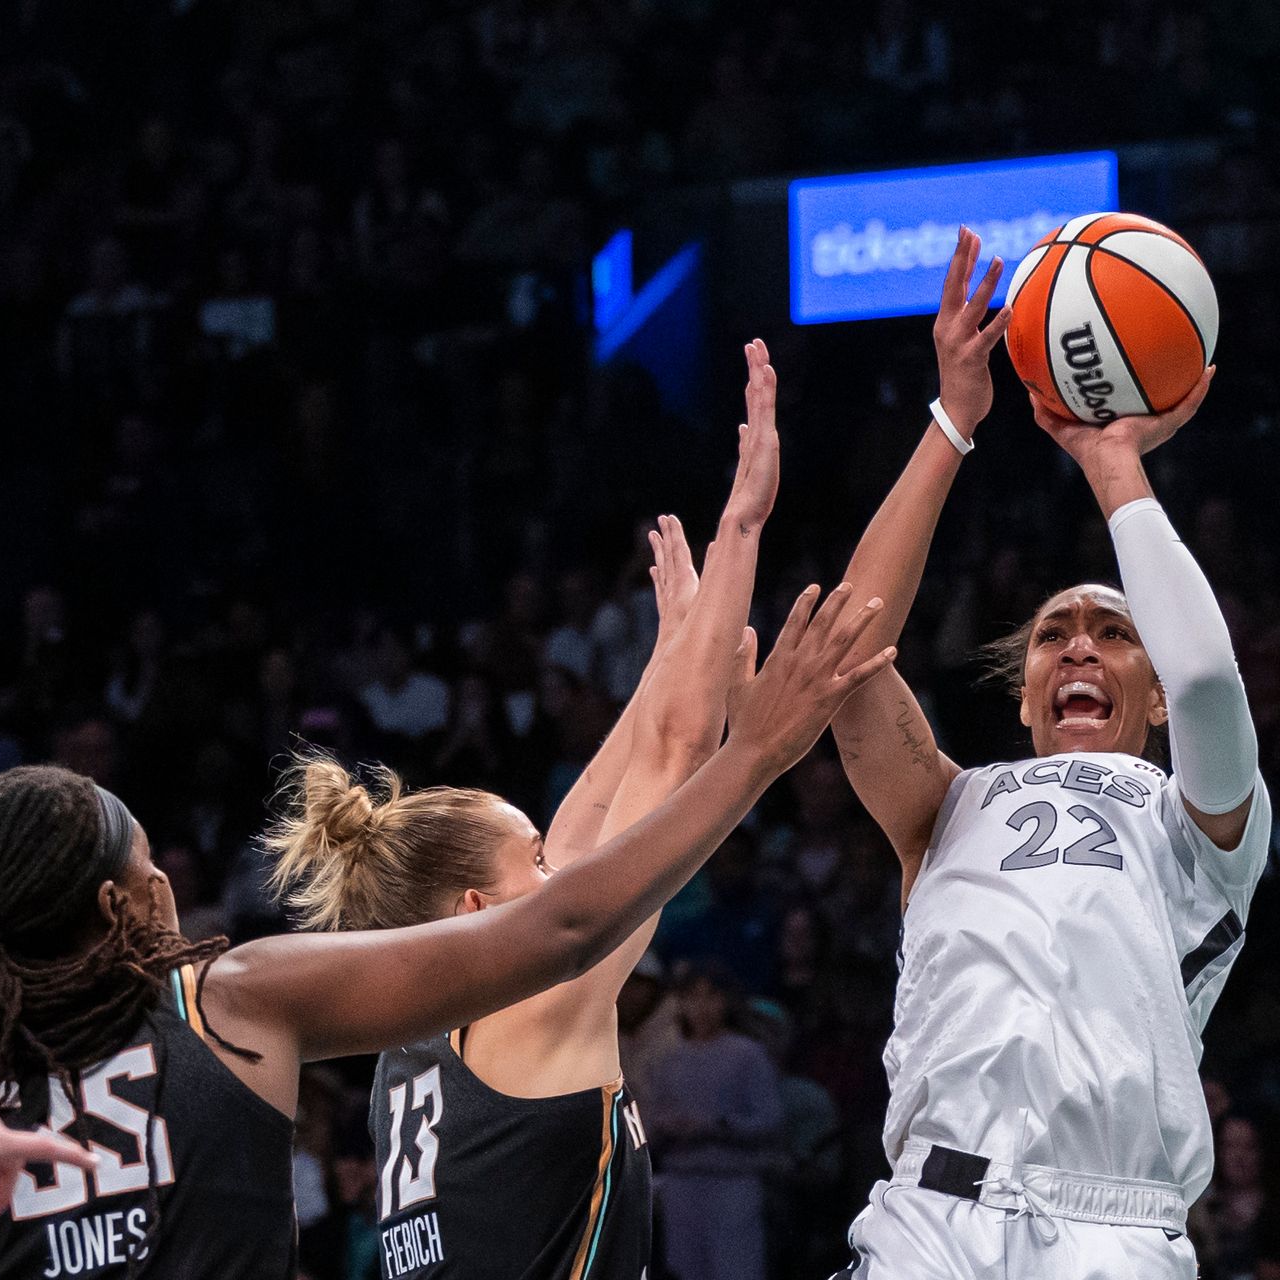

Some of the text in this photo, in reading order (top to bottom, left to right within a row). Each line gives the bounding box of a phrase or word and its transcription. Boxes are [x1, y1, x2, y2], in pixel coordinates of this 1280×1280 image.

[1060, 321, 1117, 420] Wilso
[980, 760, 1151, 810] ACES
[999, 801, 1123, 871] 22
[380, 1064, 444, 1221] 13
[43, 1207, 150, 1278] JONES
[381, 1212, 444, 1279] FIEBICH
